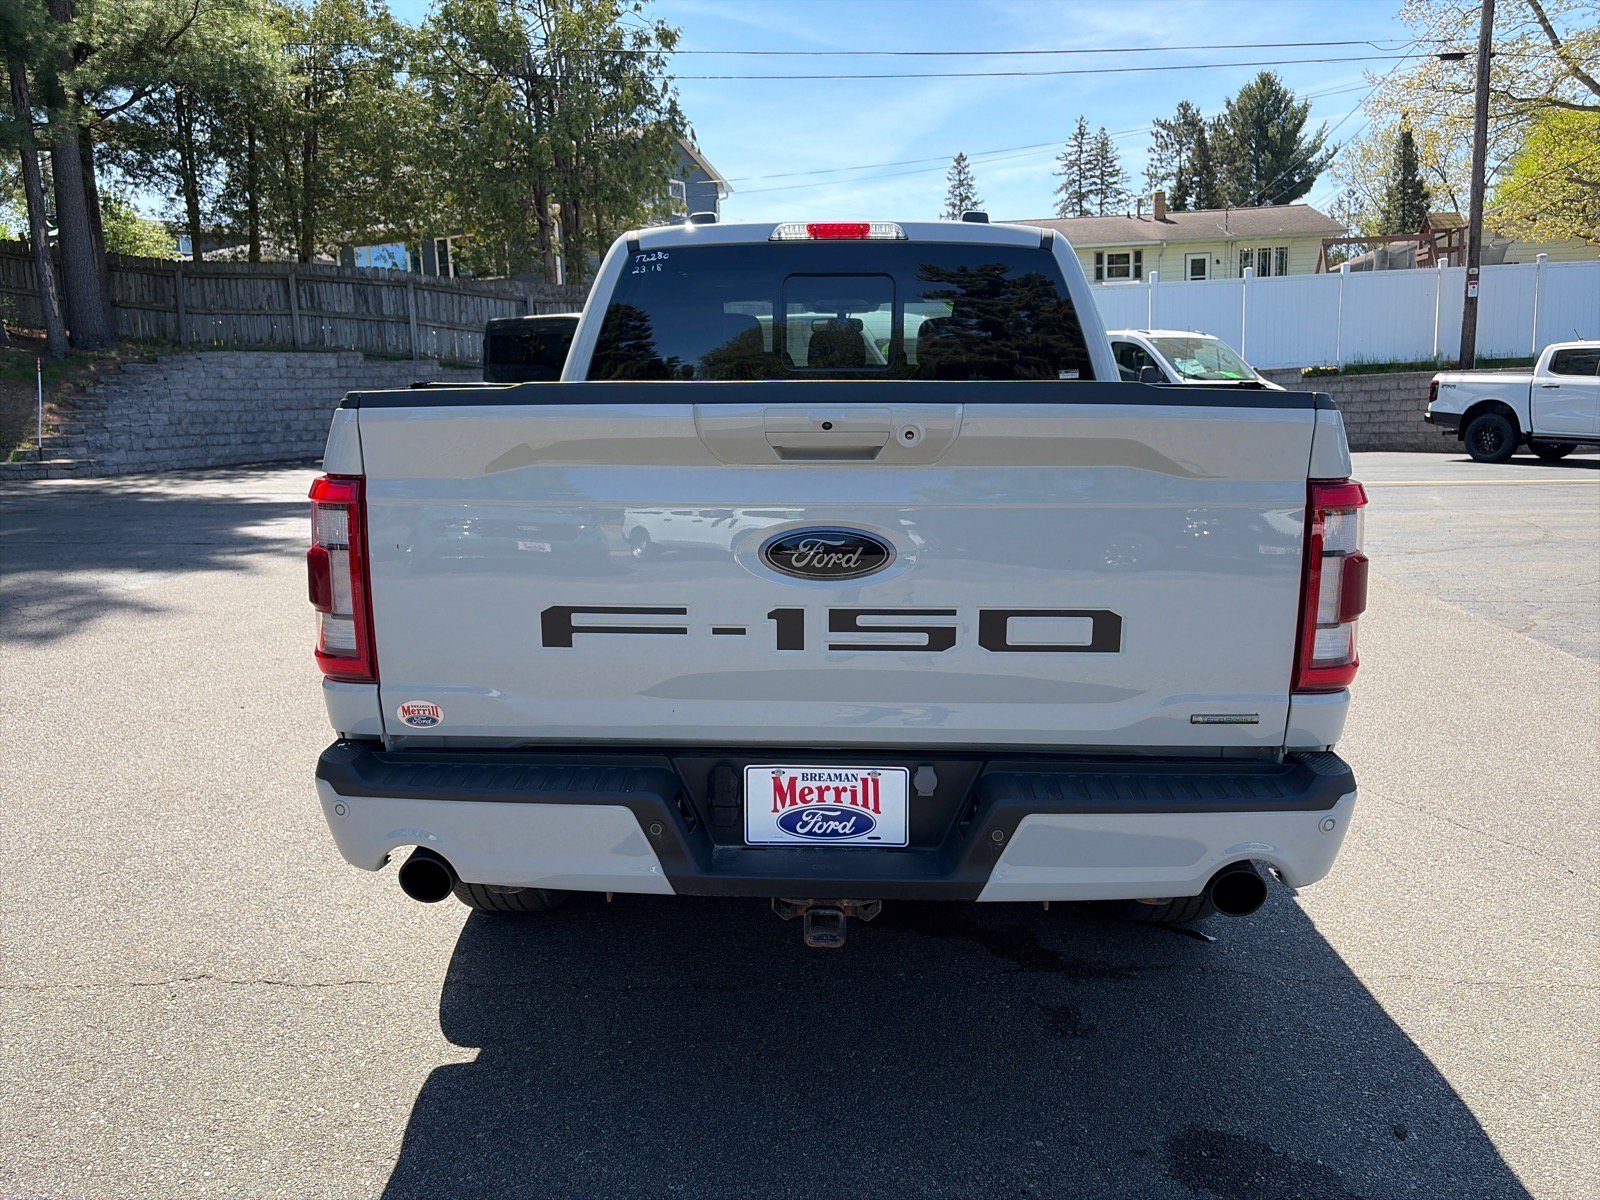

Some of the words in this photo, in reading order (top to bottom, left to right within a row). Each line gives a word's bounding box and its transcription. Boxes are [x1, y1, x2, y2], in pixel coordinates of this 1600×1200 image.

[791, 538, 863, 568] Ford
[540, 604, 1122, 653] F-150
[401, 704, 440, 718] Merrill
[411, 716, 432, 724] Ford
[801, 772, 859, 783] BREAMAN
[771, 776, 882, 815] Merrill
[796, 809, 857, 834] Ford
